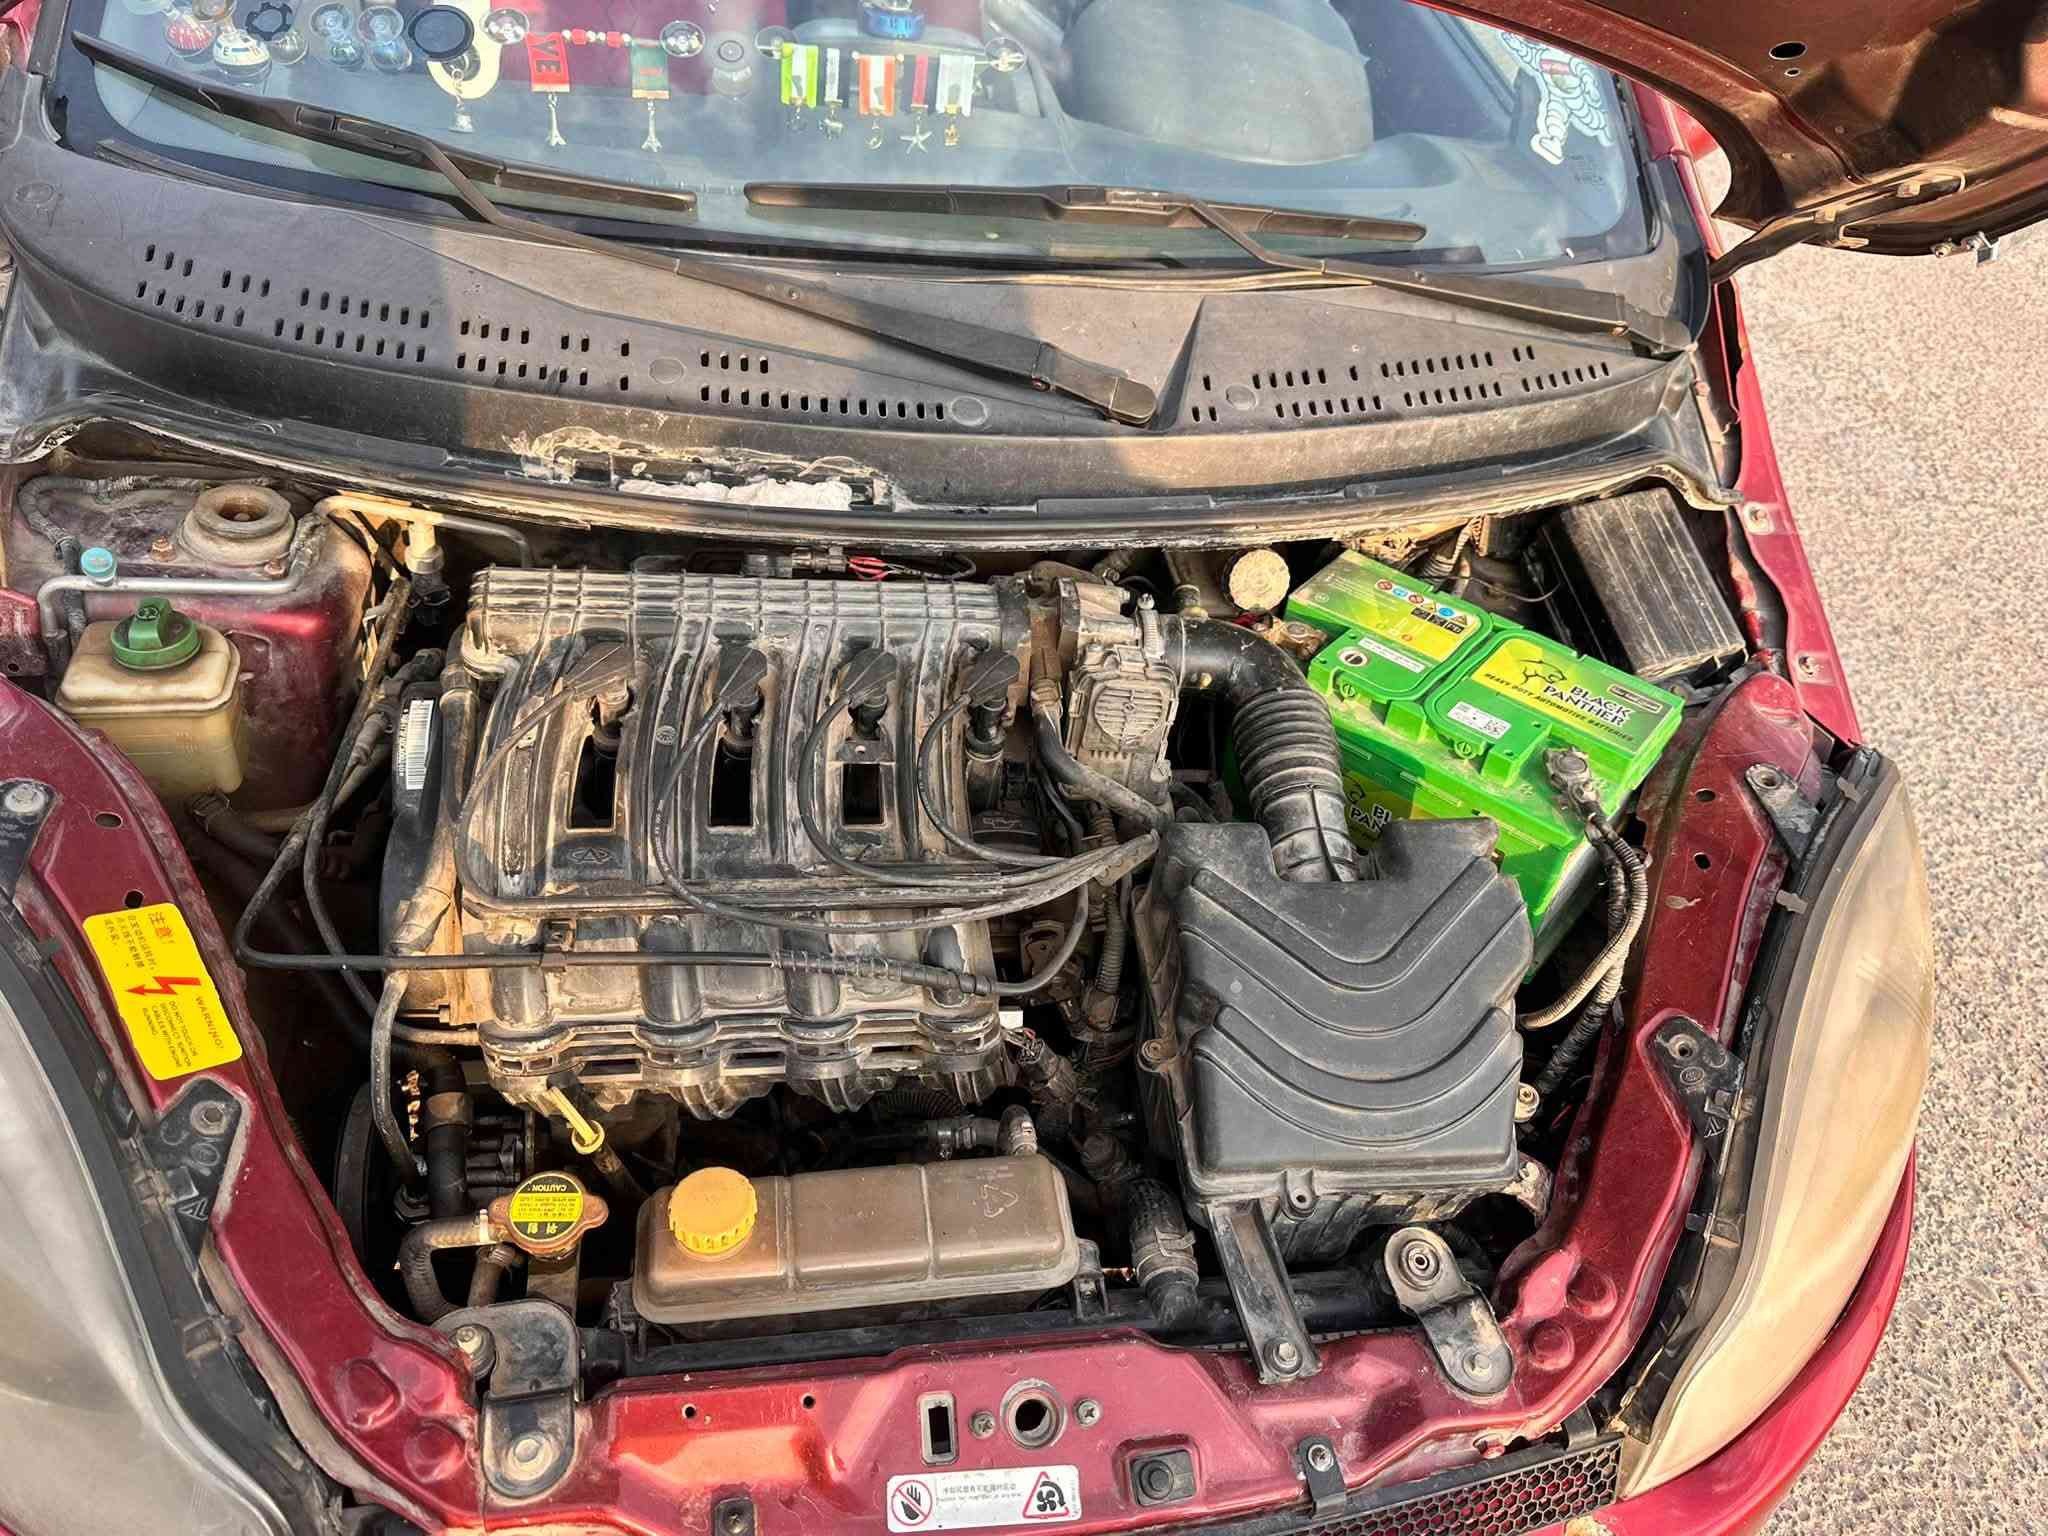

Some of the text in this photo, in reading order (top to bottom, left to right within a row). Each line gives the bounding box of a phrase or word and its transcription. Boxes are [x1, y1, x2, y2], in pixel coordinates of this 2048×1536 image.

[1484, 672, 1633, 741] HEAVY DUTY AUTOMOTIVE BATTERIES
[1543, 685, 1624, 726] PANTHER
[1570, 686, 1632, 717] BLACK
[532, 1183, 567, 1192] CAUTION
